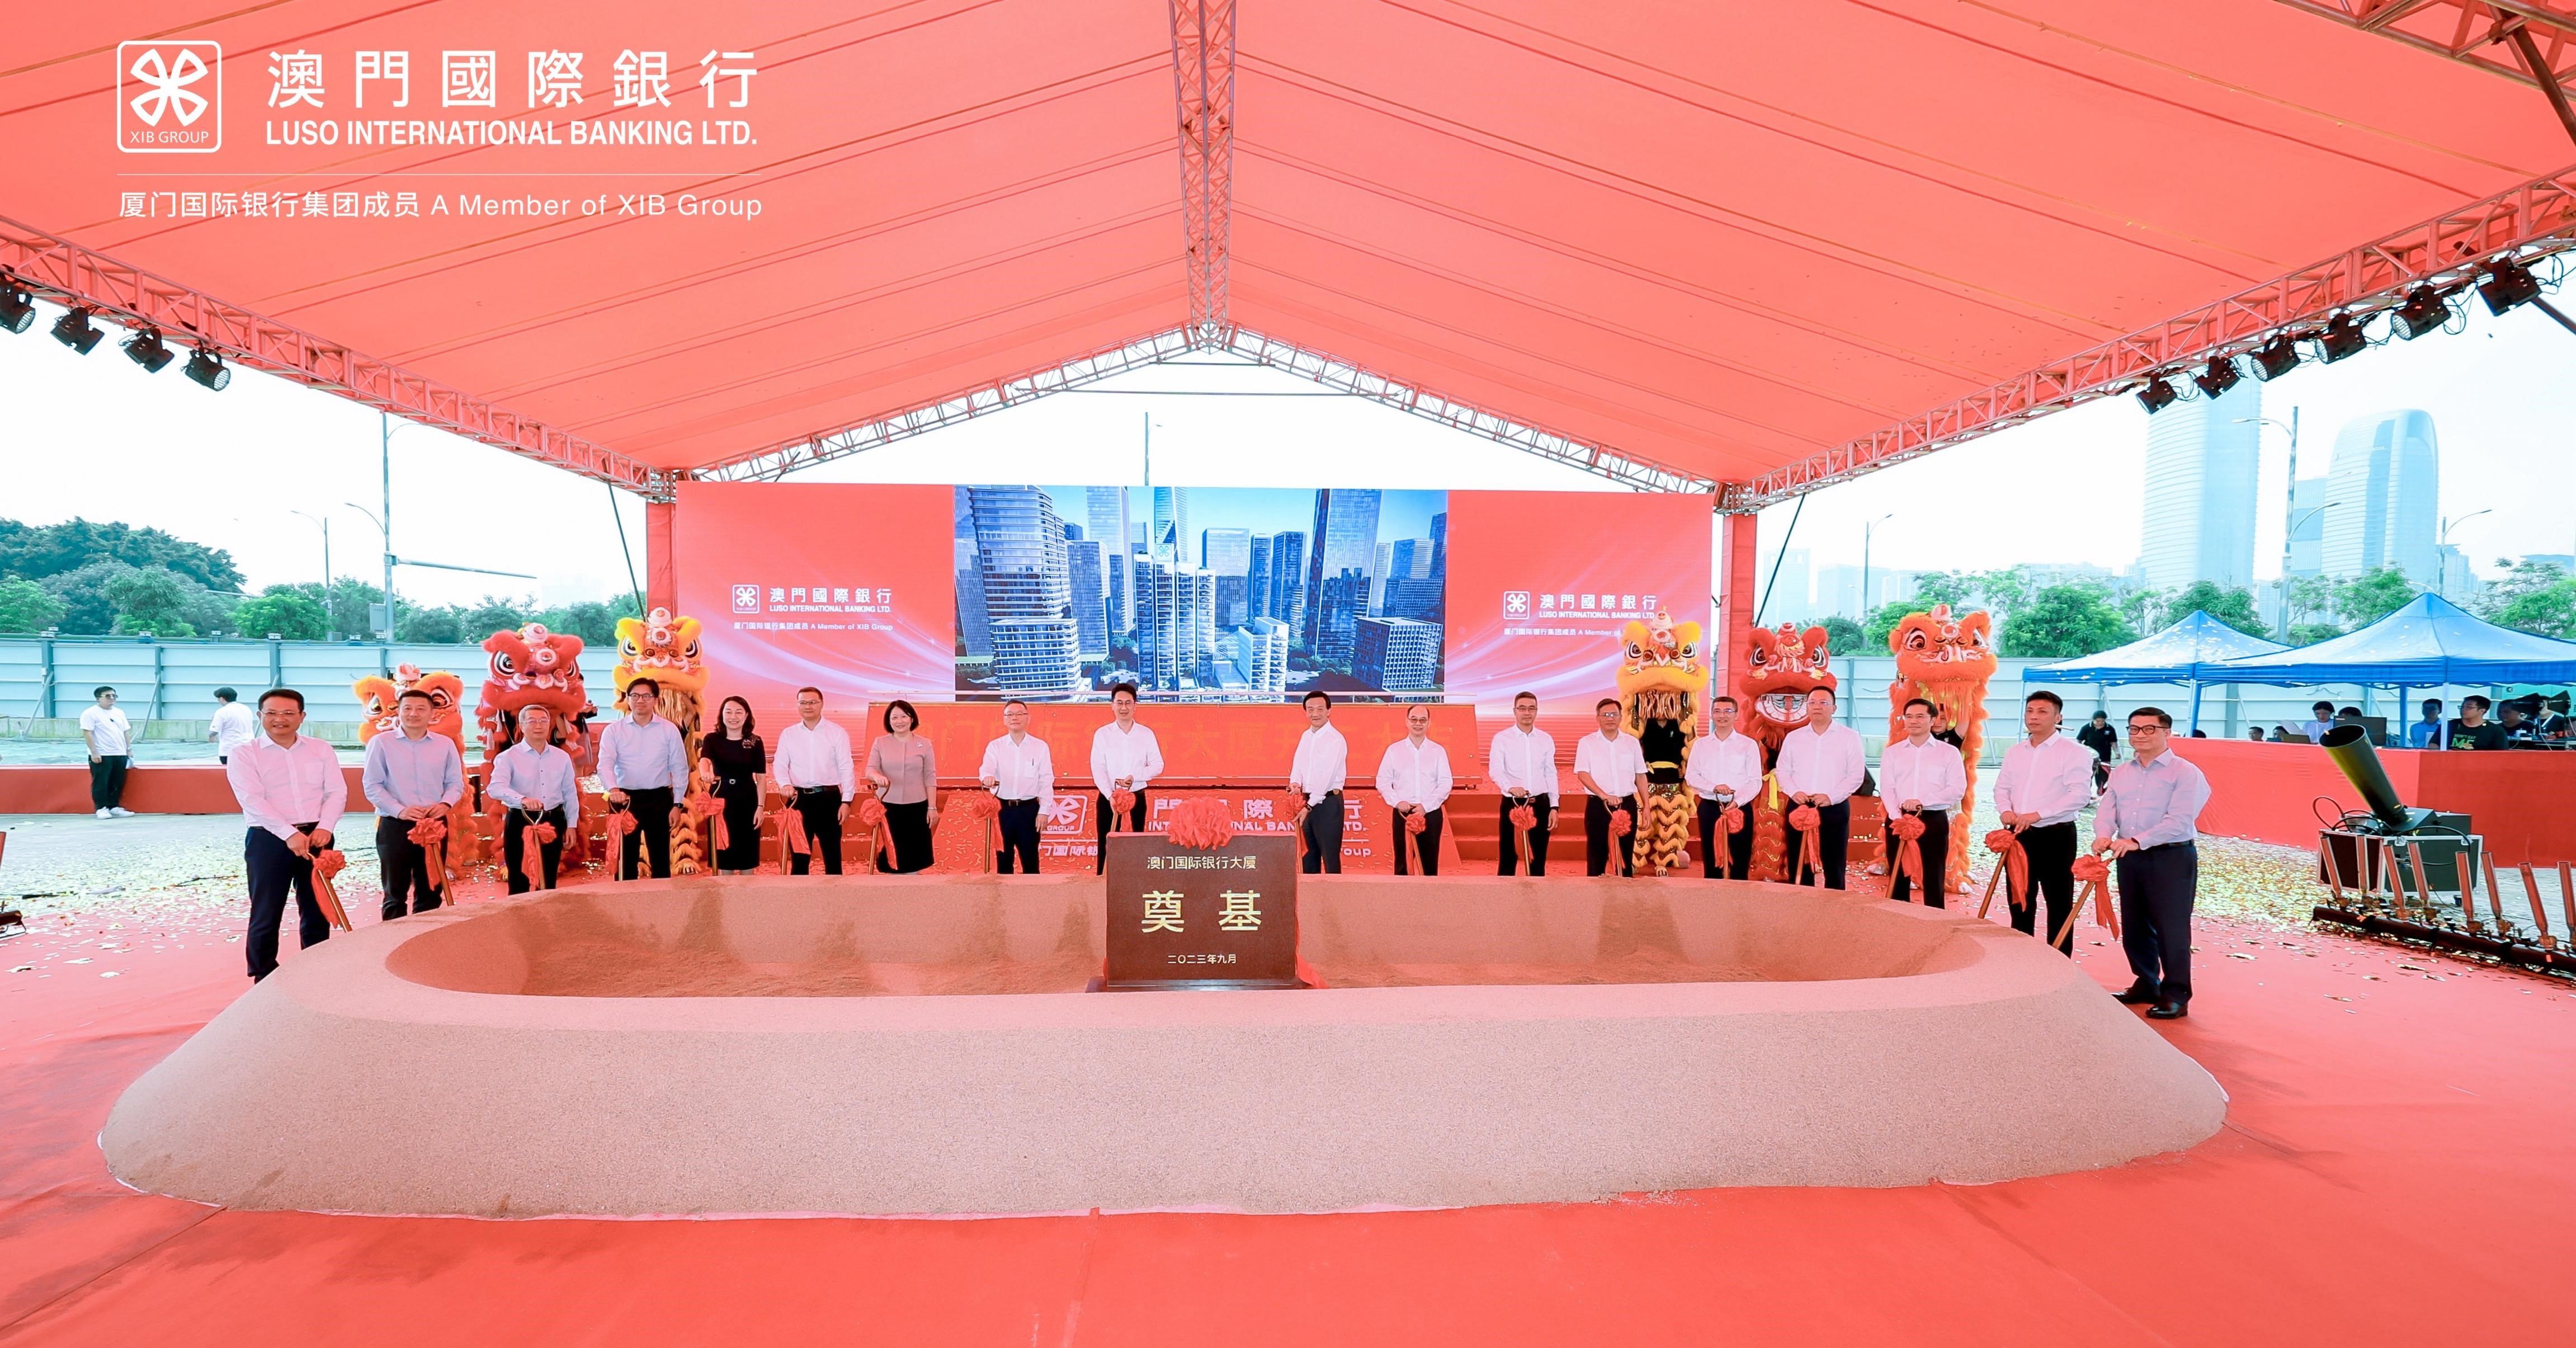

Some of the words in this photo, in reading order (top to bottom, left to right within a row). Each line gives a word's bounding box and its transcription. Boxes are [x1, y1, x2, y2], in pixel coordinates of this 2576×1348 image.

[770, 587, 891, 604] 澳門國際銀行
[1540, 594, 1657, 610] 澳門國際銀行
[1343, 821, 1368, 831] TD.
[1341, 847, 1371, 857] oup
[1147, 856, 1257, 870] 澳门国际银行大厦
